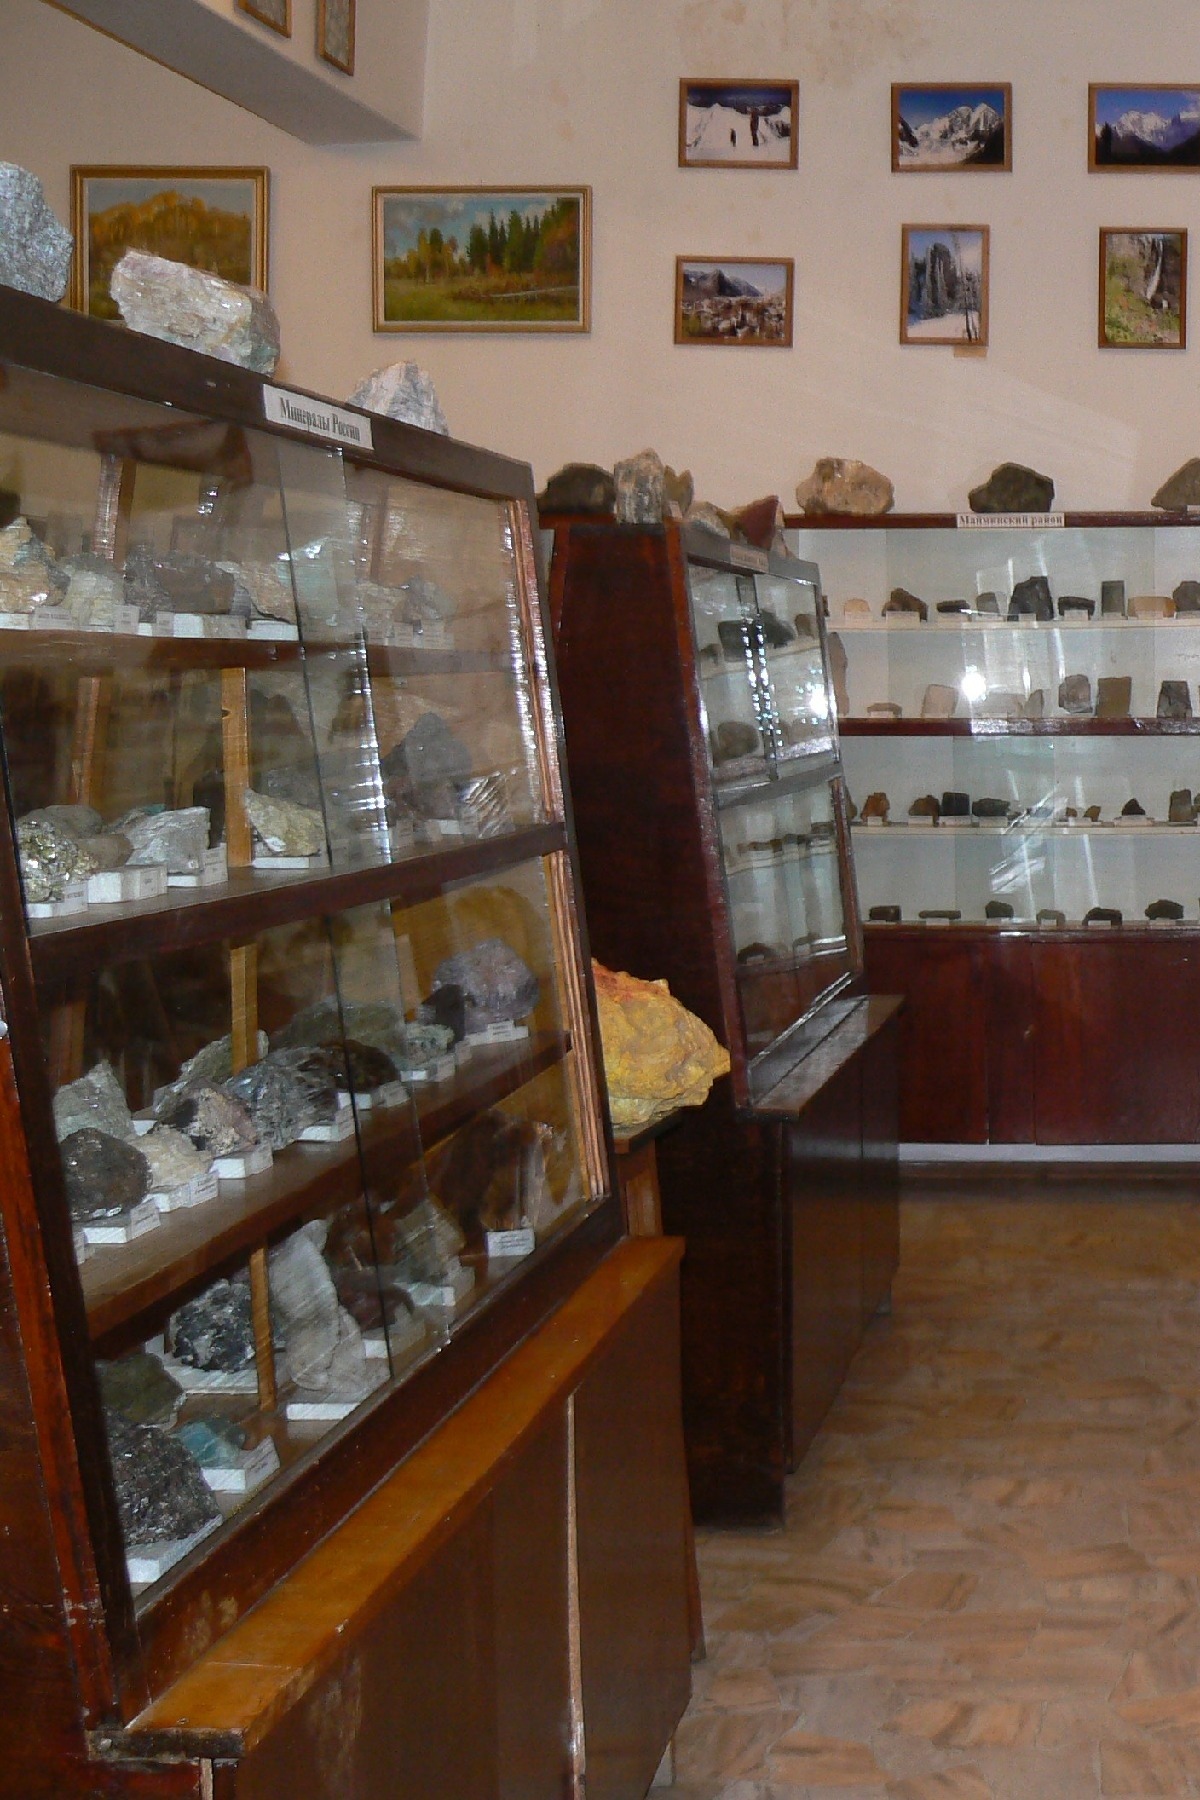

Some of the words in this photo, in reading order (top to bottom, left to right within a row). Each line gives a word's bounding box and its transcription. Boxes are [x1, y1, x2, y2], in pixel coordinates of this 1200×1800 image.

[279, 397, 330, 432] Минералы
[332, 412, 361, 442] России
[1030, 513, 1063, 527] район
